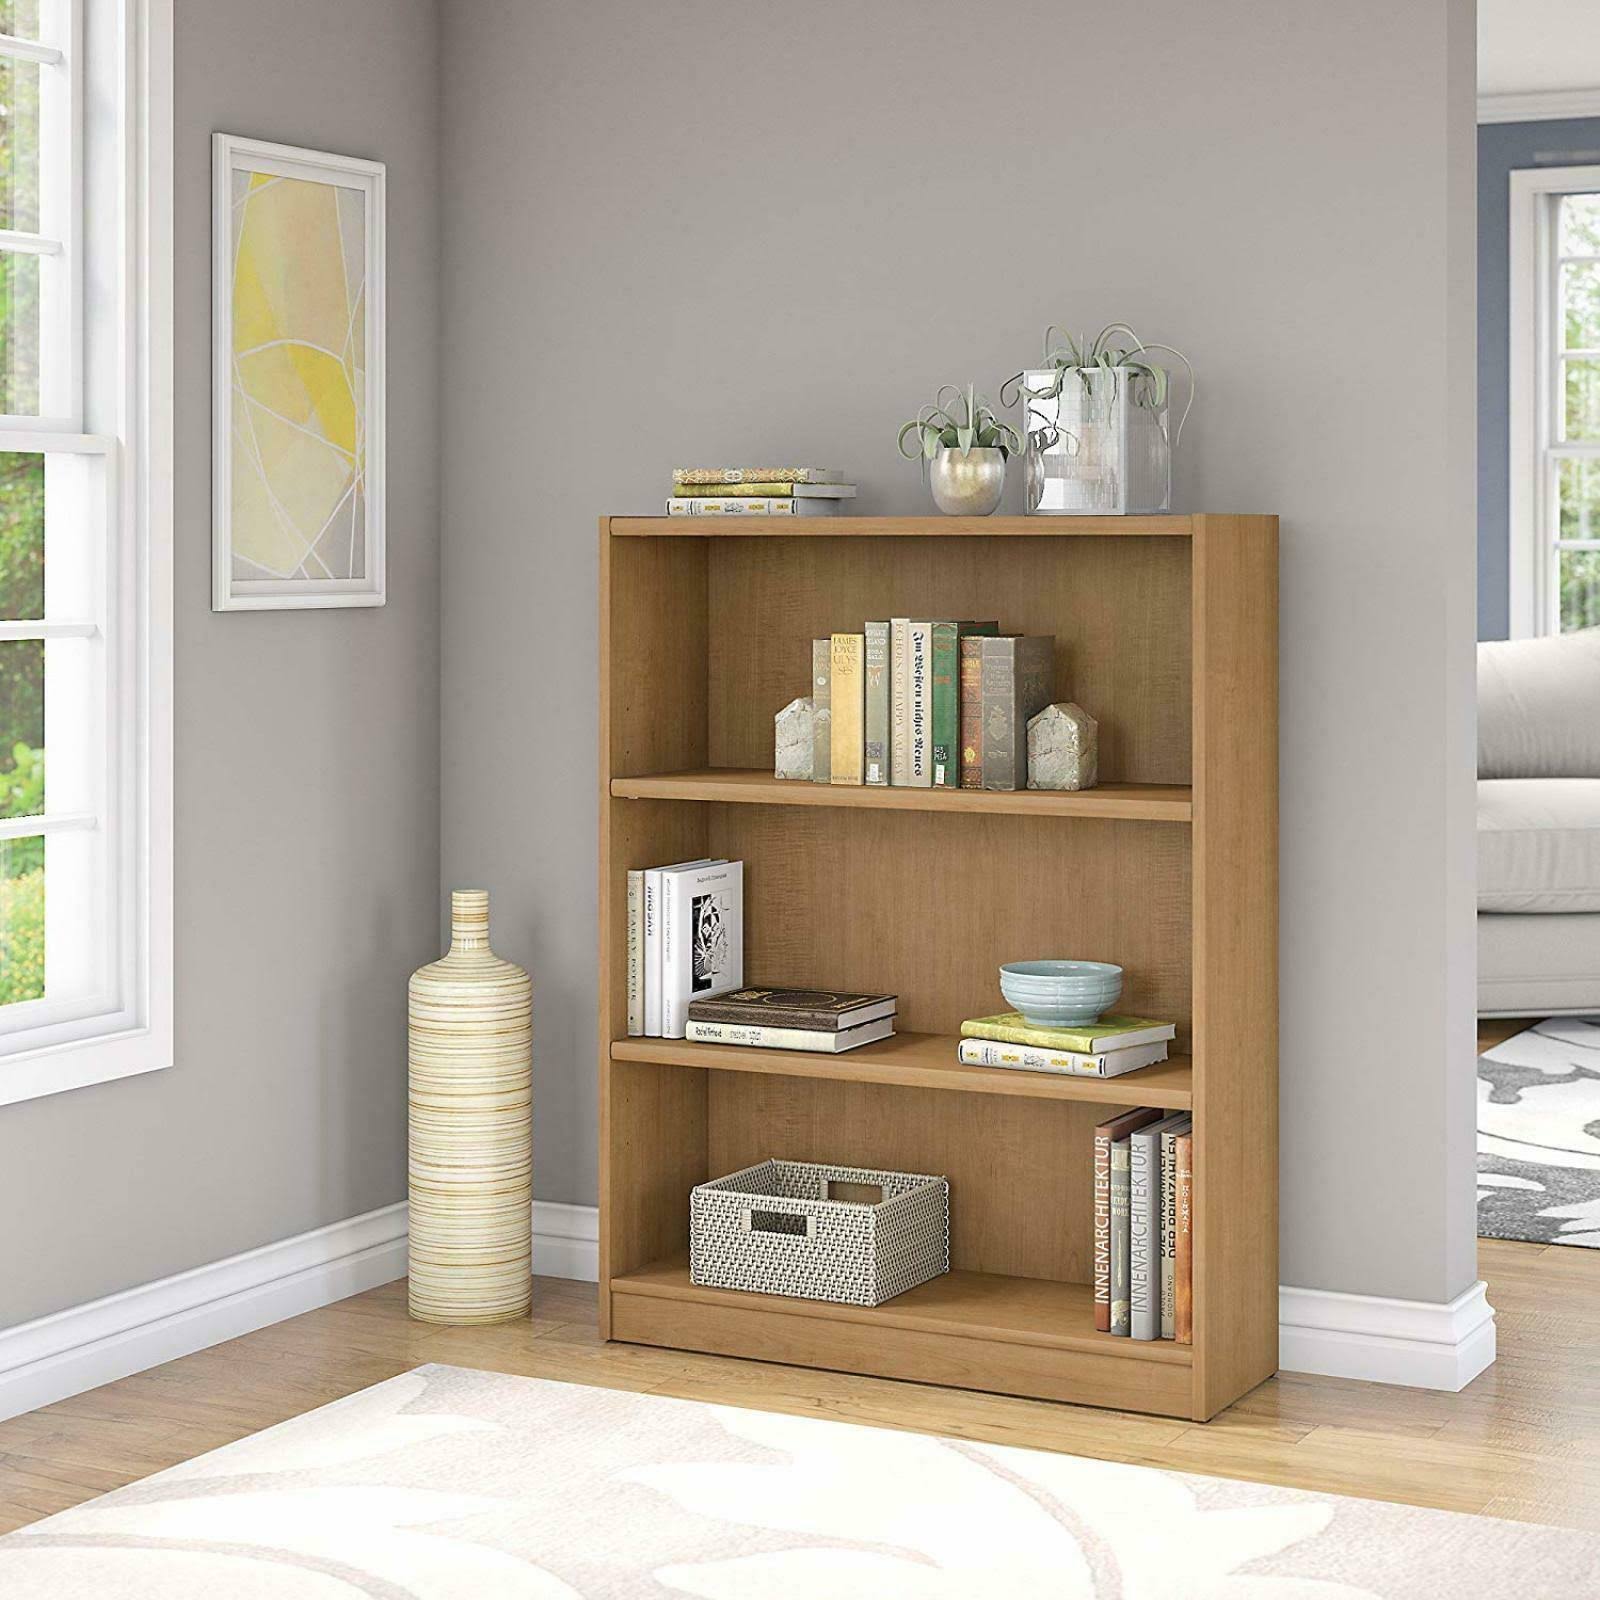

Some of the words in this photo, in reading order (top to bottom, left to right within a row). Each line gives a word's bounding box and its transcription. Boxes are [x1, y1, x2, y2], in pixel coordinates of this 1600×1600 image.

[895, 623, 904, 669] ECHOES
[895, 672, 904, 687] OF
[895, 691, 904, 728] HAPPY
[895, 733, 904, 776] VALLEY
[1094, 1136, 1110, 1304] INNENARCHITEKTUR
[1131, 1144, 1148, 1313] INNENARCHITEKTUR
